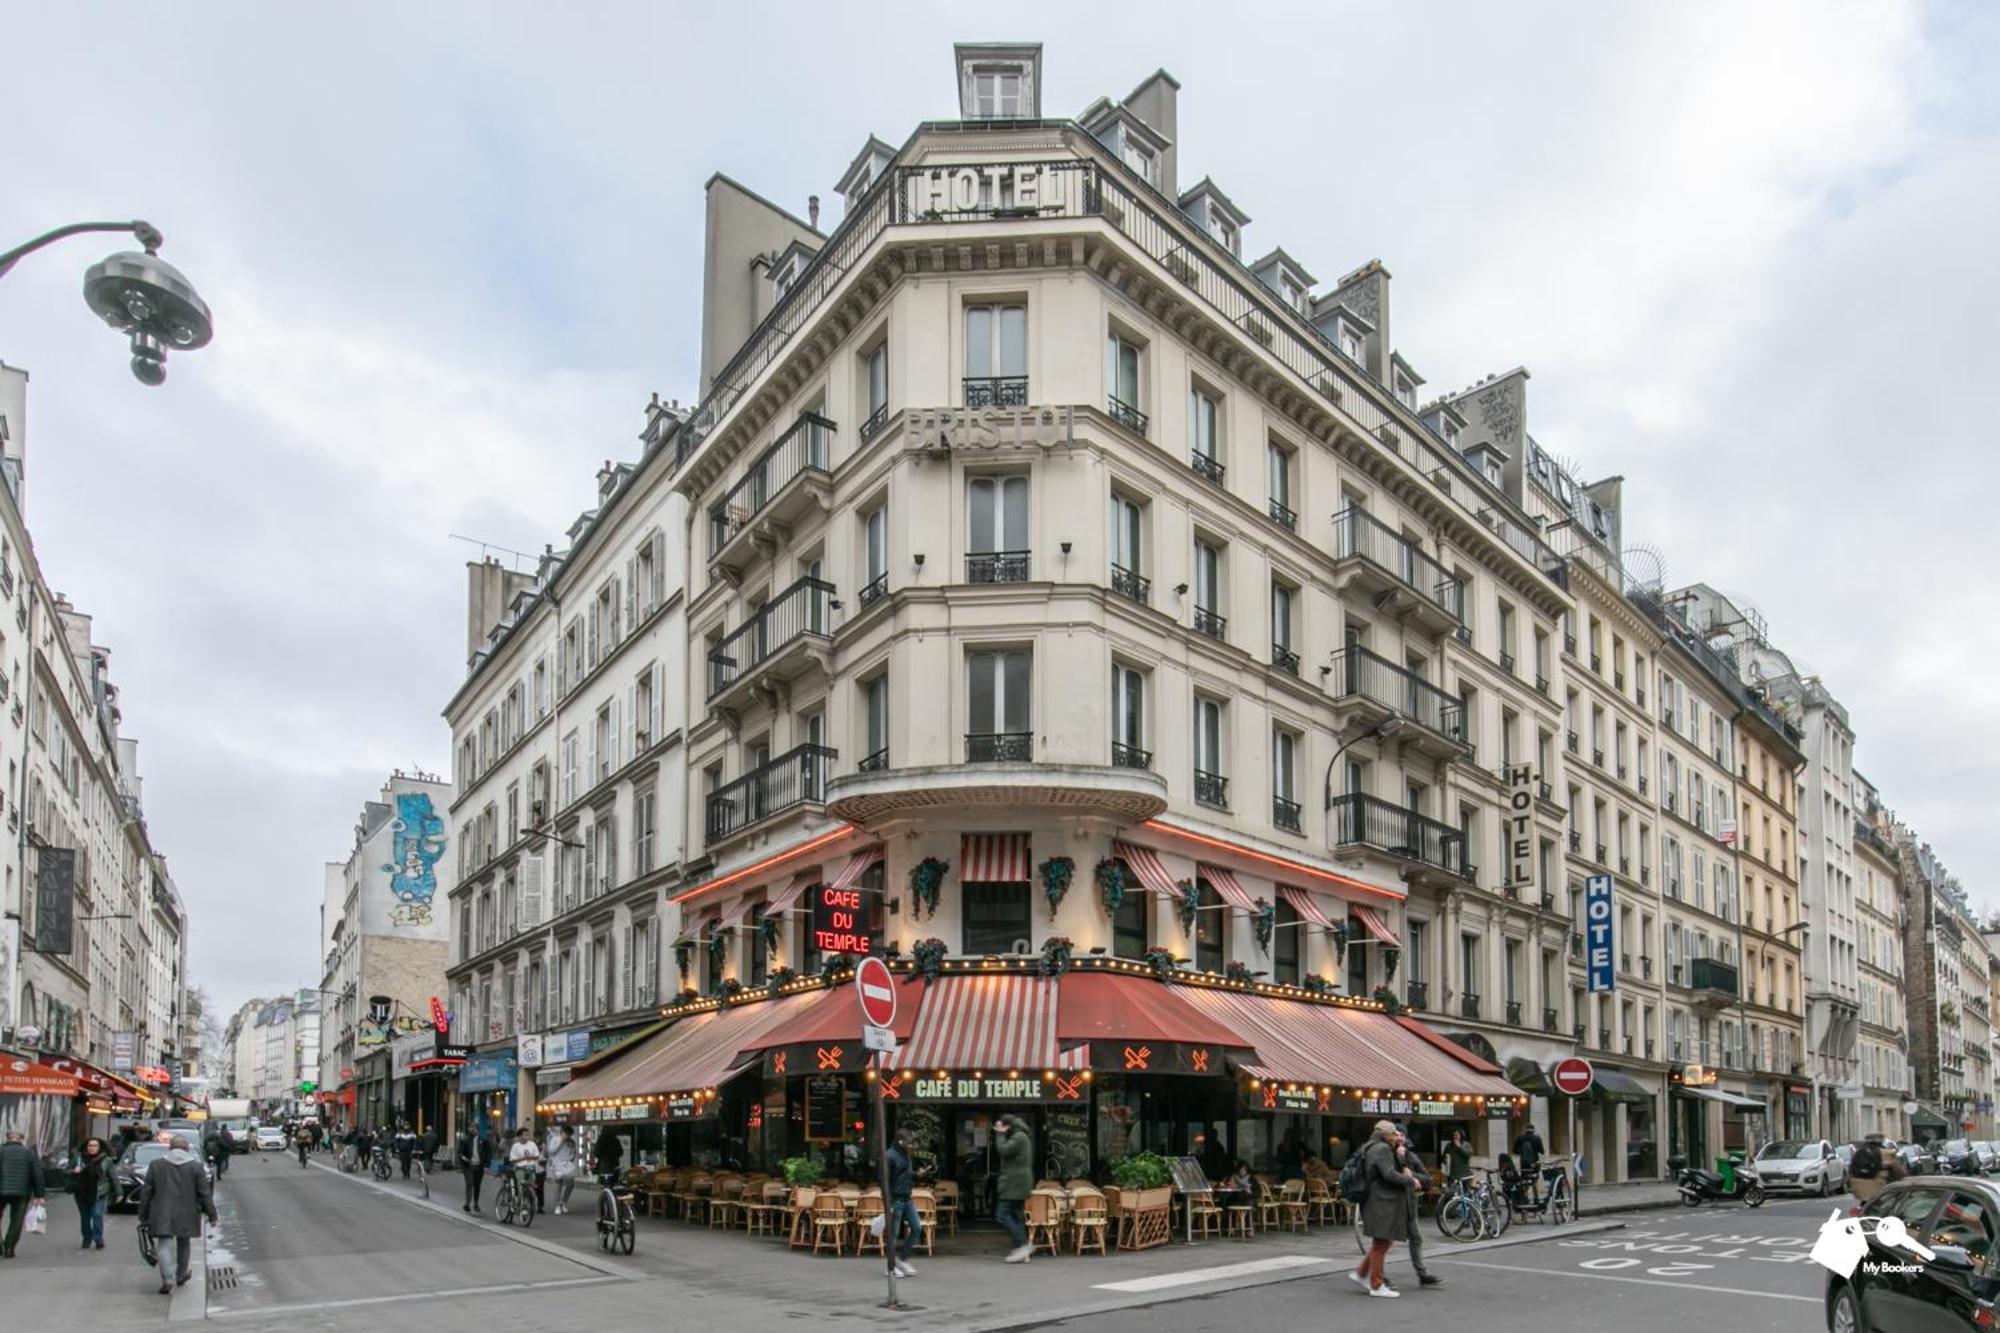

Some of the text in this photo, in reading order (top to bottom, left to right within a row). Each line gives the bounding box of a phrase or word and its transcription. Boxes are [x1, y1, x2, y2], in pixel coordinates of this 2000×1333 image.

[923, 165, 1066, 212] HOTEL
[904, 404, 1089, 450] BRISTOL
[1511, 766, 1531, 883] HOTEL
[37, 852, 59, 948] SAUNA
[824, 889, 860, 909] CAFE
[833, 912, 853, 929] DU
[816, 931, 870, 952] TEMPLE
[1589, 876, 1610, 991] HOTEL
[443, 1049, 467, 1057] TABAC
[915, 1077, 1041, 1098] CAFÉ DU TEMPLE
[1579, 1257, 1716, 1277] 20
